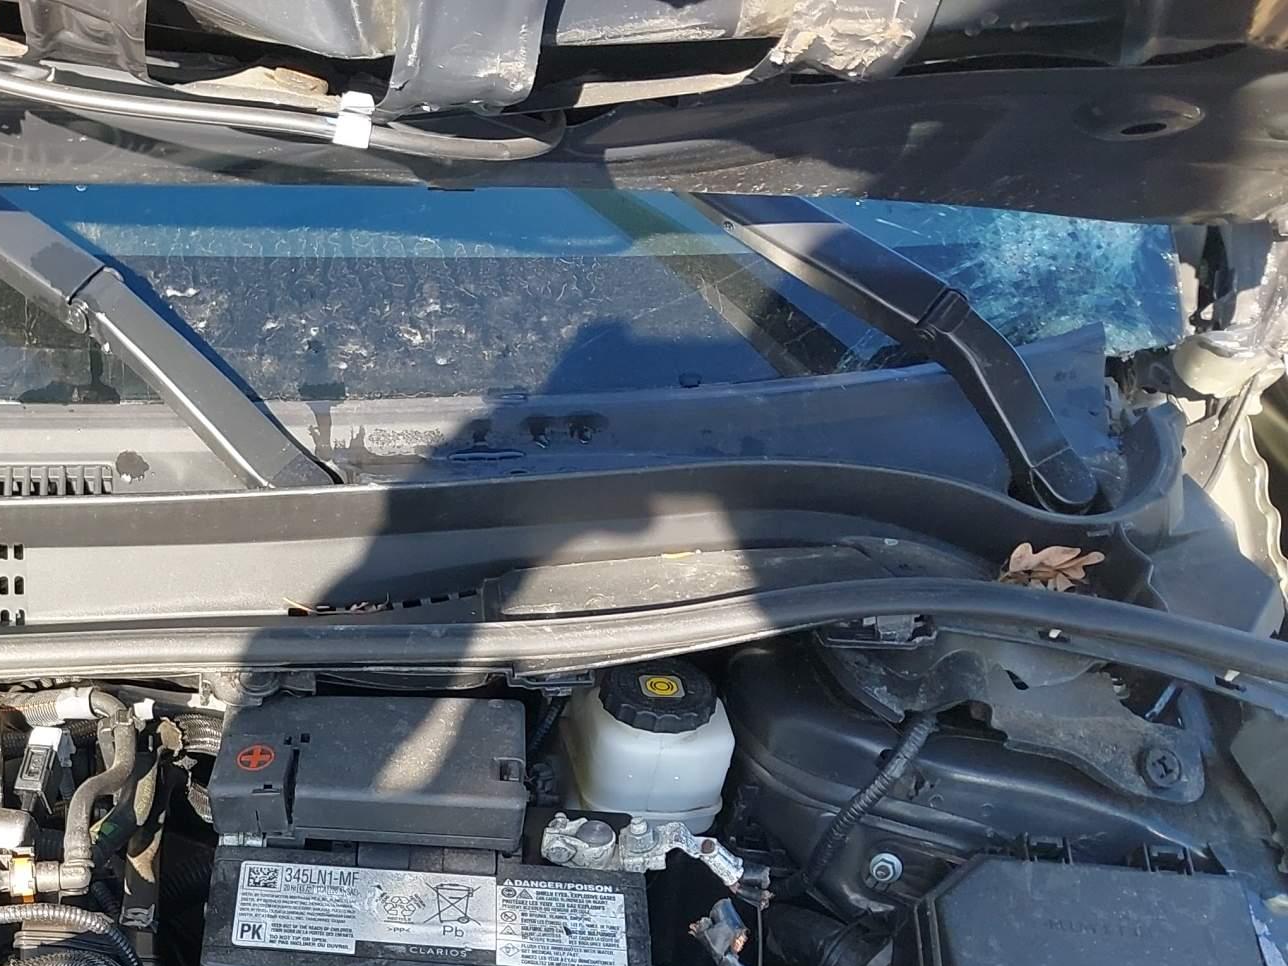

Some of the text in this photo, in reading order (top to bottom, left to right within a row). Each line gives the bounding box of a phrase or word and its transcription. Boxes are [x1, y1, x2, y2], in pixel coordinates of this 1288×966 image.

[284, 867, 360, 887] 345LN1-MF
[514, 879, 613, 892] DANGER/POISON
[239, 923, 263, 940] PK
[442, 925, 465, 938] Pb
[409, 946, 467, 959] CLARIOS
